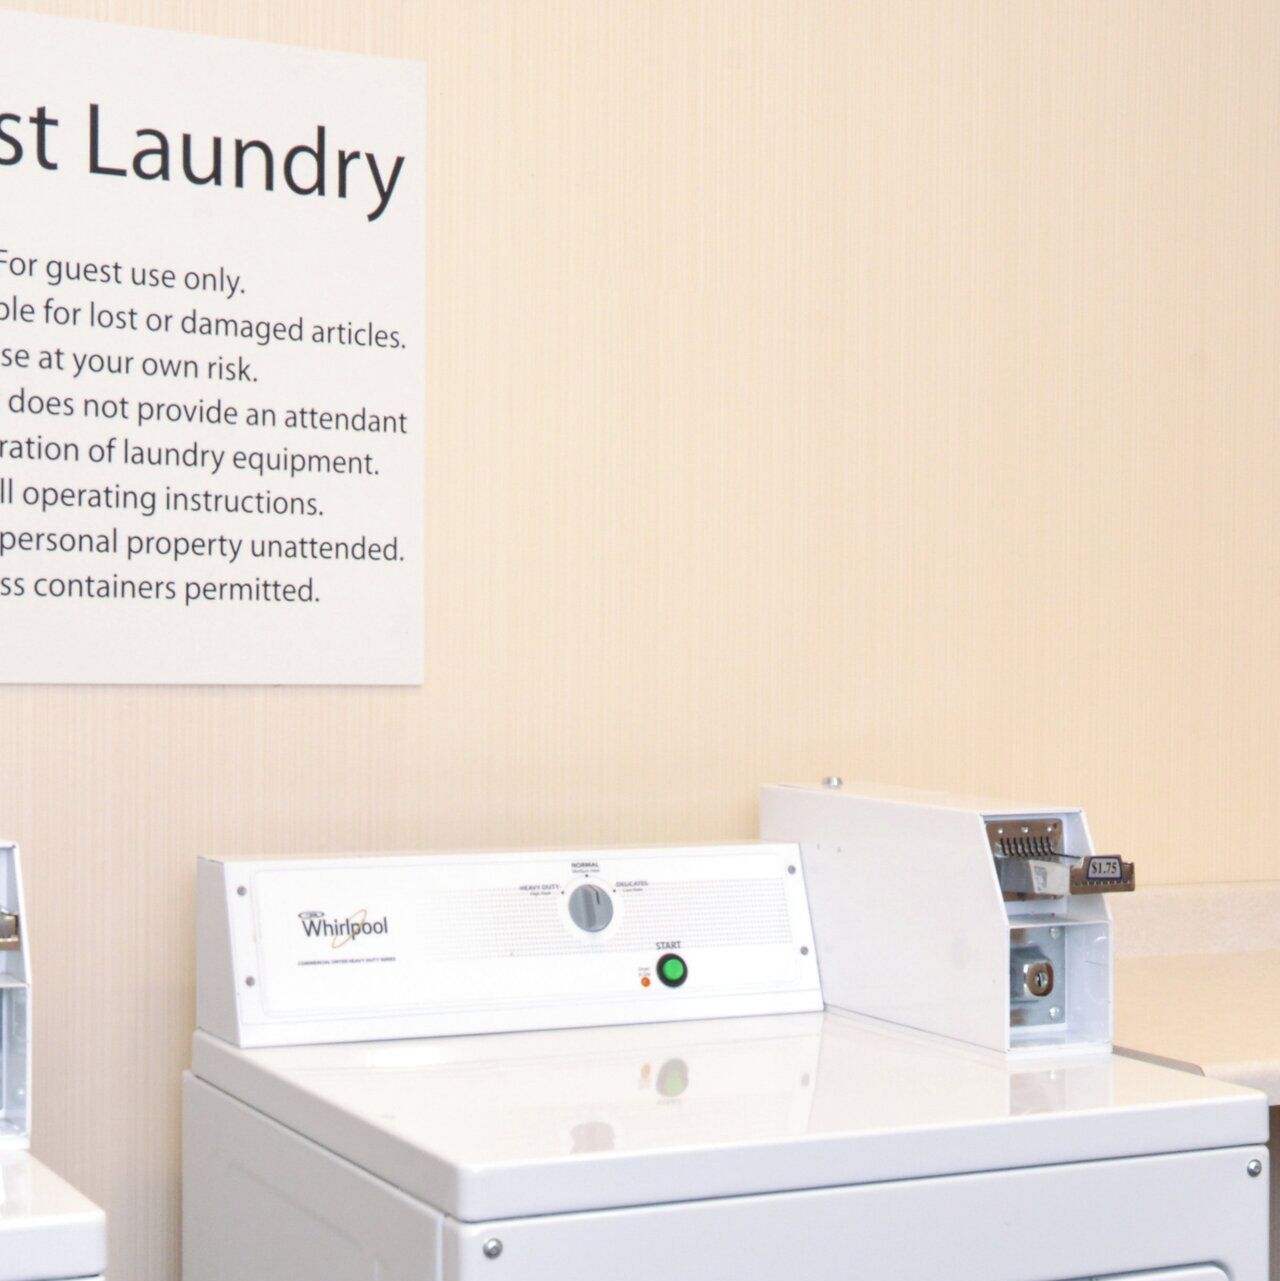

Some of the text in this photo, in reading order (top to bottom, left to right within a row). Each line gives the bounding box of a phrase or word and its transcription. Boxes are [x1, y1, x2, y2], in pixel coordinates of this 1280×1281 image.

[89, 103, 405, 222] Laundry
[46, 260, 122, 286] guest
[131, 267, 176, 288] use
[184, 267, 245, 300] only.
[44, 297, 81, 326] for
[90, 301, 137, 330] lost
[146, 313, 173, 332] or
[181, 309, 303, 346] damaged
[312, 322, 405, 349] articles.
[38, 348, 64, 370] at
[72, 353, 134, 378] your
[142, 357, 198, 378] own
[208, 356, 257, 382] risk.
[8, 387, 74, 416] does
[84, 397, 129, 419] not
[138, 399, 238, 426] provide
[246, 408, 276, 426] an
[284, 407, 407, 434] attendant
[88, 437, 117, 463] of
[124, 438, 225, 475] laundry
[233, 451, 378, 478] equipment.
[22, 486, 156, 517] operating
[166, 490, 323, 516] instructions.
[0, 527, 117, 557] personal
[127, 535, 243, 563] property
[251, 535, 403, 561] unattended.
[34, 576, 176, 600] containers
[185, 577, 319, 606] permitted.
[1091, 861, 1117, 874] $1.75
[301, 916, 388, 941] Whirlpool
[655, 940, 681, 950] START
